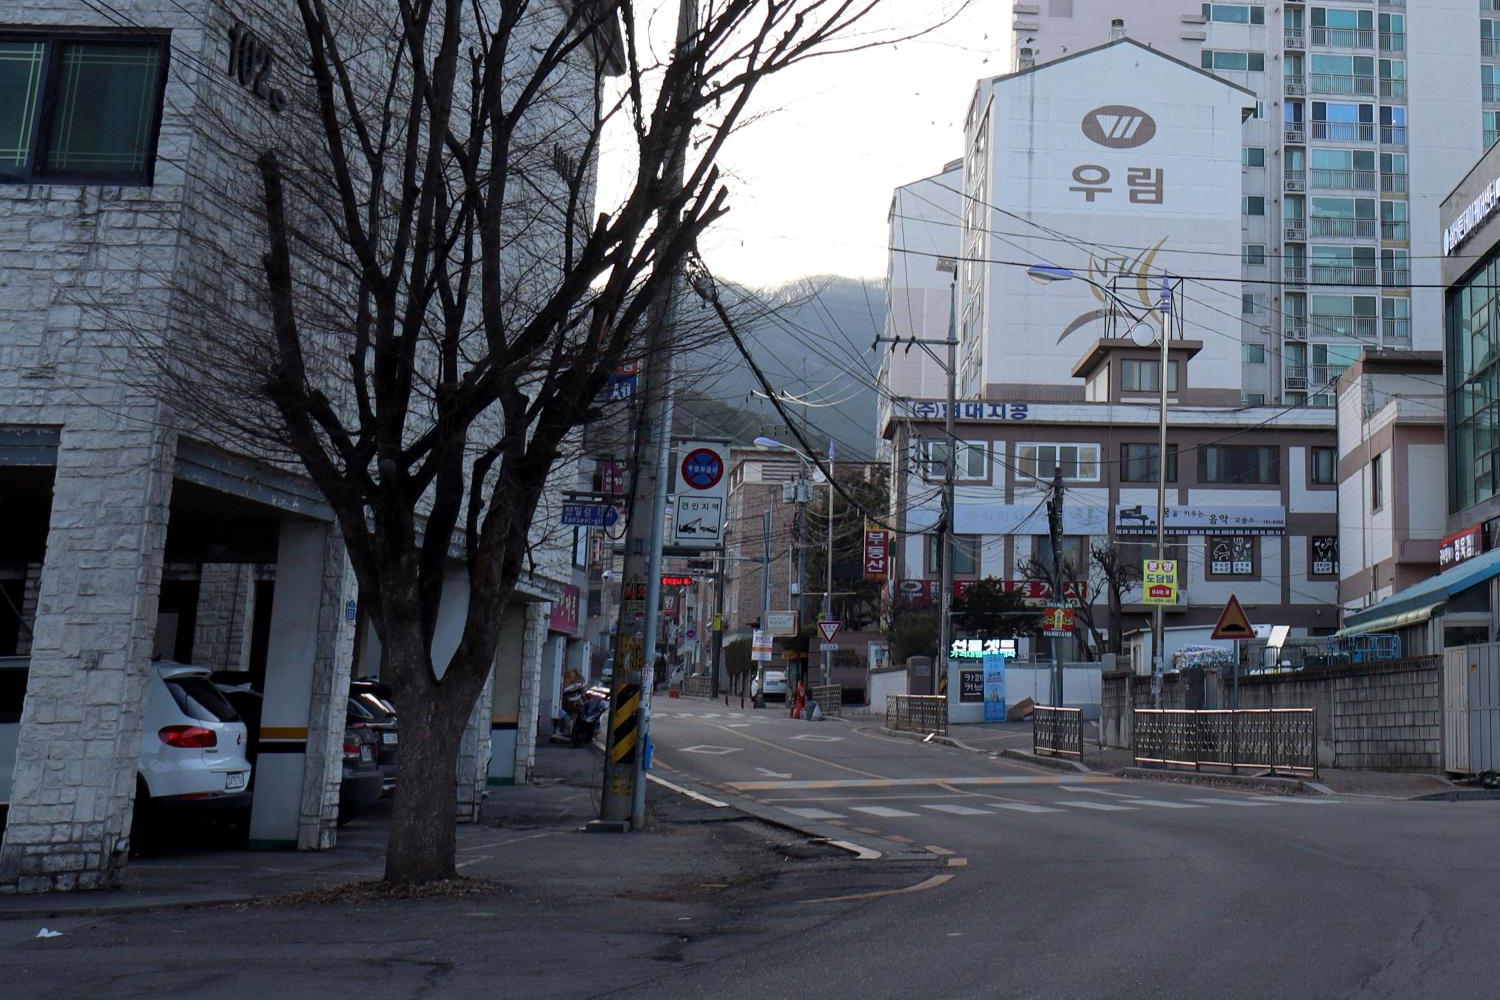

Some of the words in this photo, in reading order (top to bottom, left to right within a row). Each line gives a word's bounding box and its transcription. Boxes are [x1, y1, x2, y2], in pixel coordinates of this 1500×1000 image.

[1068, 164, 1164, 205] 우림
[681, 502, 719, 512] 견인지역
[1208, 513, 1228, 525] 음악
[867, 532, 886, 573] 부동산
